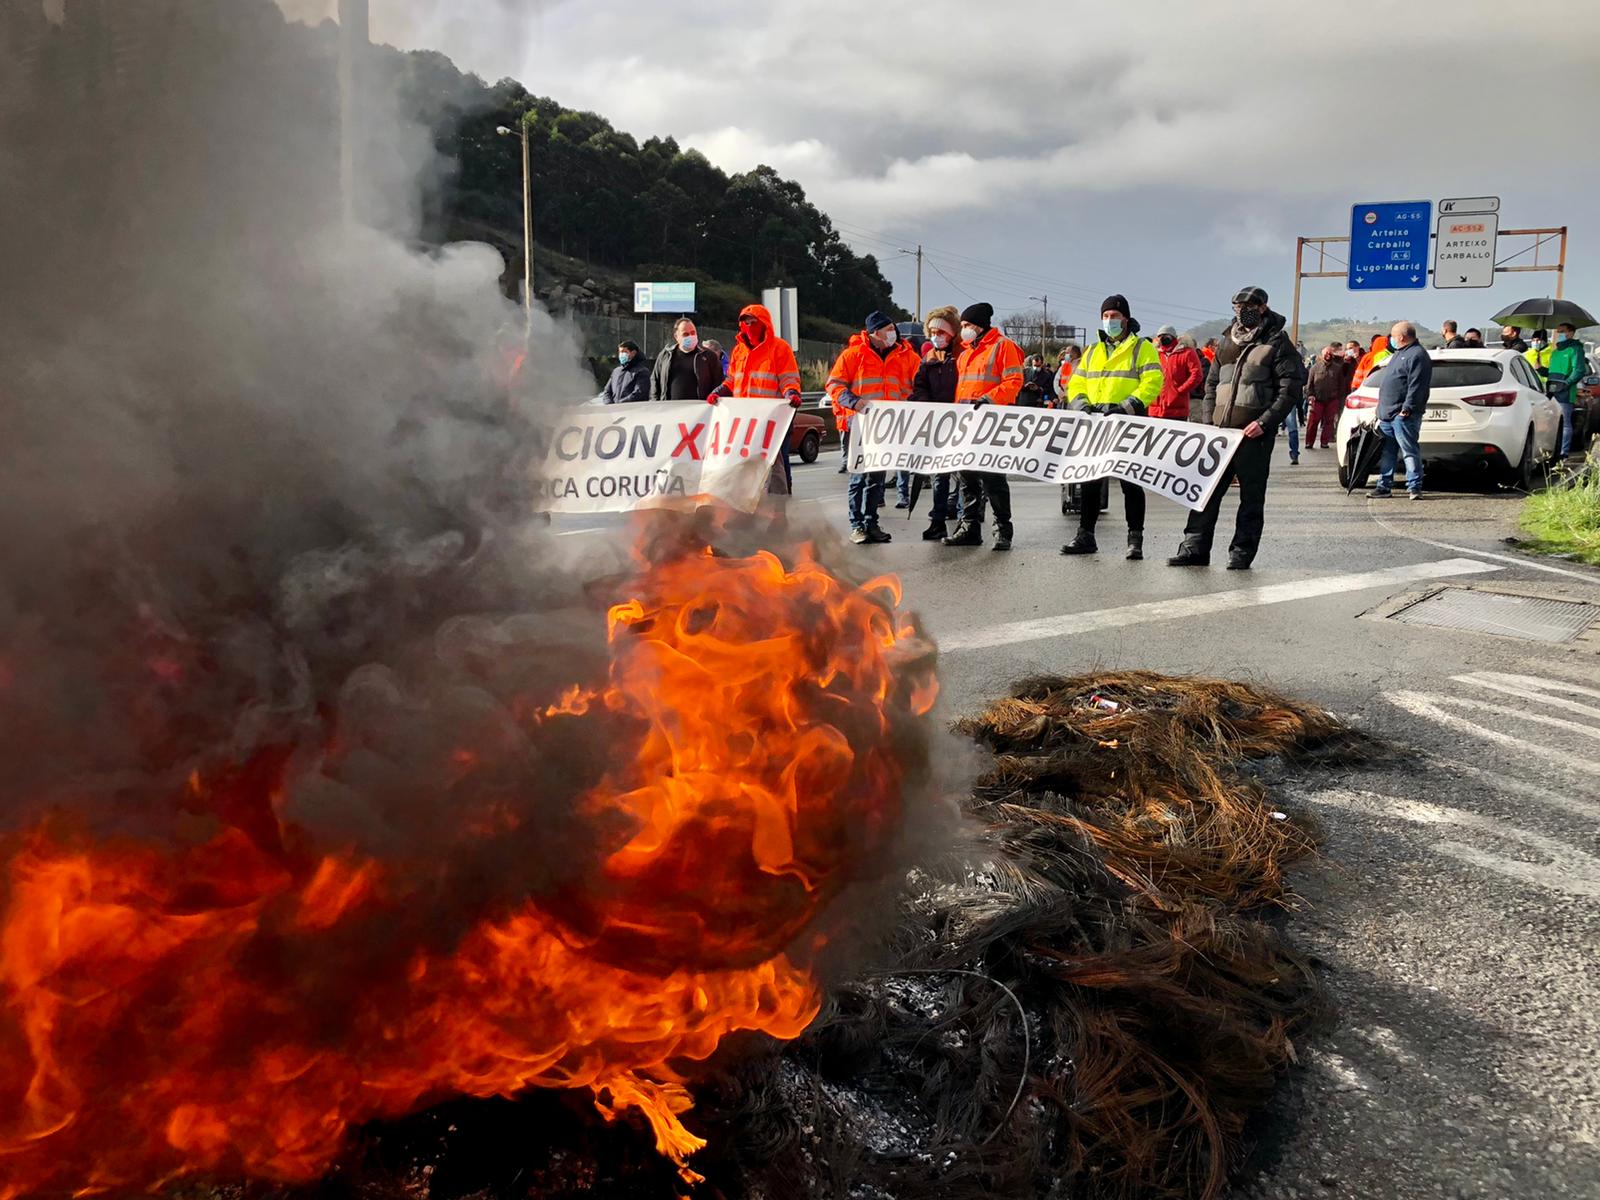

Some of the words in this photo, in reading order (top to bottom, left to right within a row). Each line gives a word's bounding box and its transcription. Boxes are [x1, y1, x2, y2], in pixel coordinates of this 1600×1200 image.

[1371, 229, 1409, 237] Arteixo
[1368, 241, 1411, 249] Carballo
[1446, 239, 1487, 247] ARTEIXO
[1440, 252, 1490, 260] CARBALLO
[1356, 263, 1420, 273] Lugo-Madrid
[858, 407, 916, 447] NON
[910, 410, 974, 449] AOS
[971, 411, 1228, 477] DESPEDIMENTOS
[854, 451, 893, 470] POLO
[895, 451, 977, 470] EMPREGO
[978, 452, 1040, 474] DIGNO
[1043, 462, 1059, 479] E
[1062, 462, 1100, 480] CON
[1101, 459, 1203, 503] DEREITOS
[586, 468, 686, 498] CORUÑA
